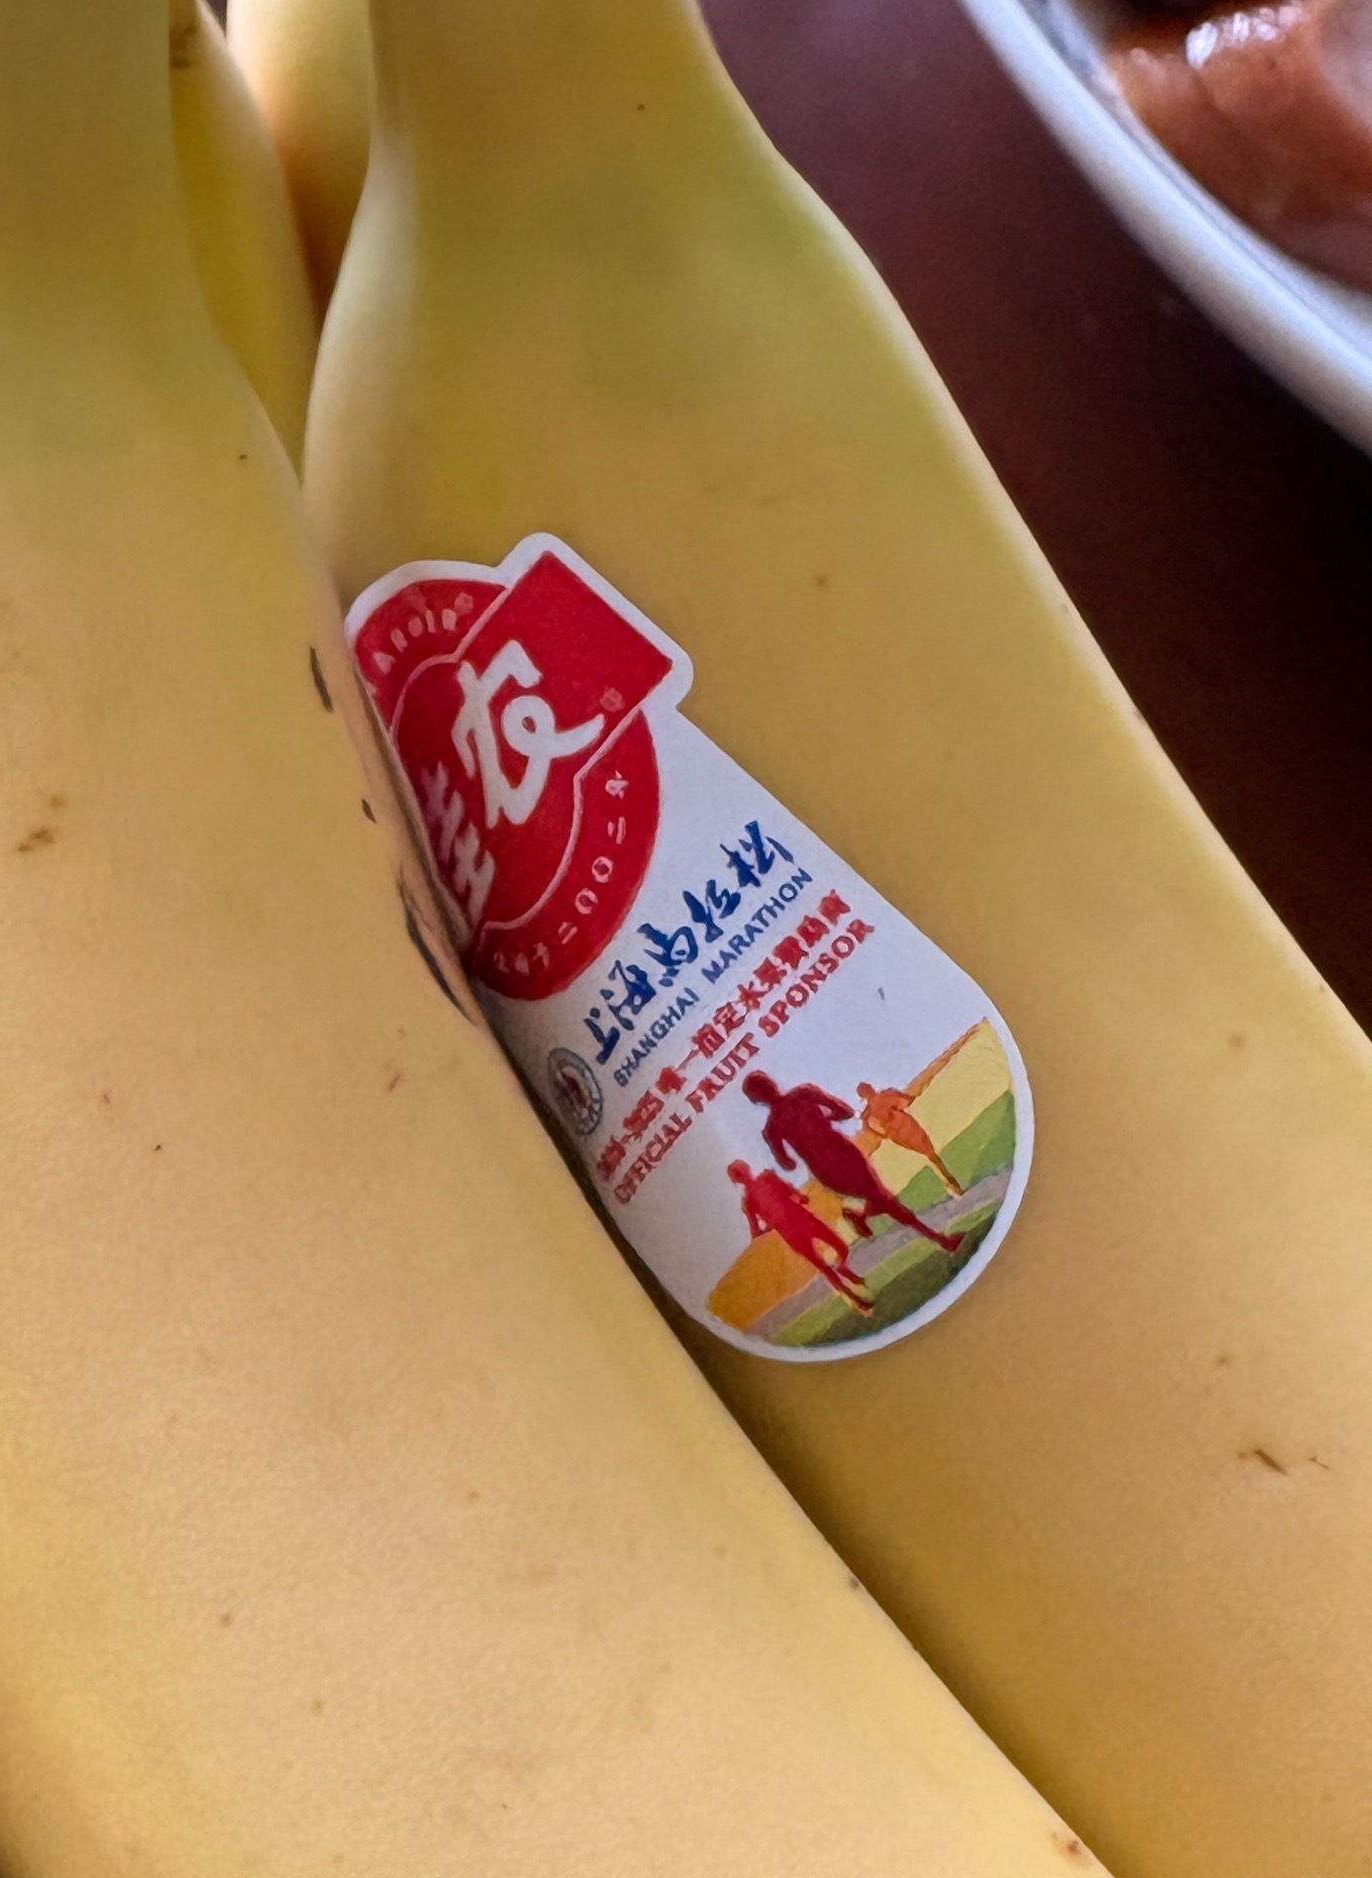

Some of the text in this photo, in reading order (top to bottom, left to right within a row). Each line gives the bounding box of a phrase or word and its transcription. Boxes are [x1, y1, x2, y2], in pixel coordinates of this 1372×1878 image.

[584, 820, 795, 1065] 上海马拉松
[613, 868, 813, 1087] SHANGHAI MARATHON
[613, 918, 874, 1204] OFFICIAL FRUIT SPONSOR
